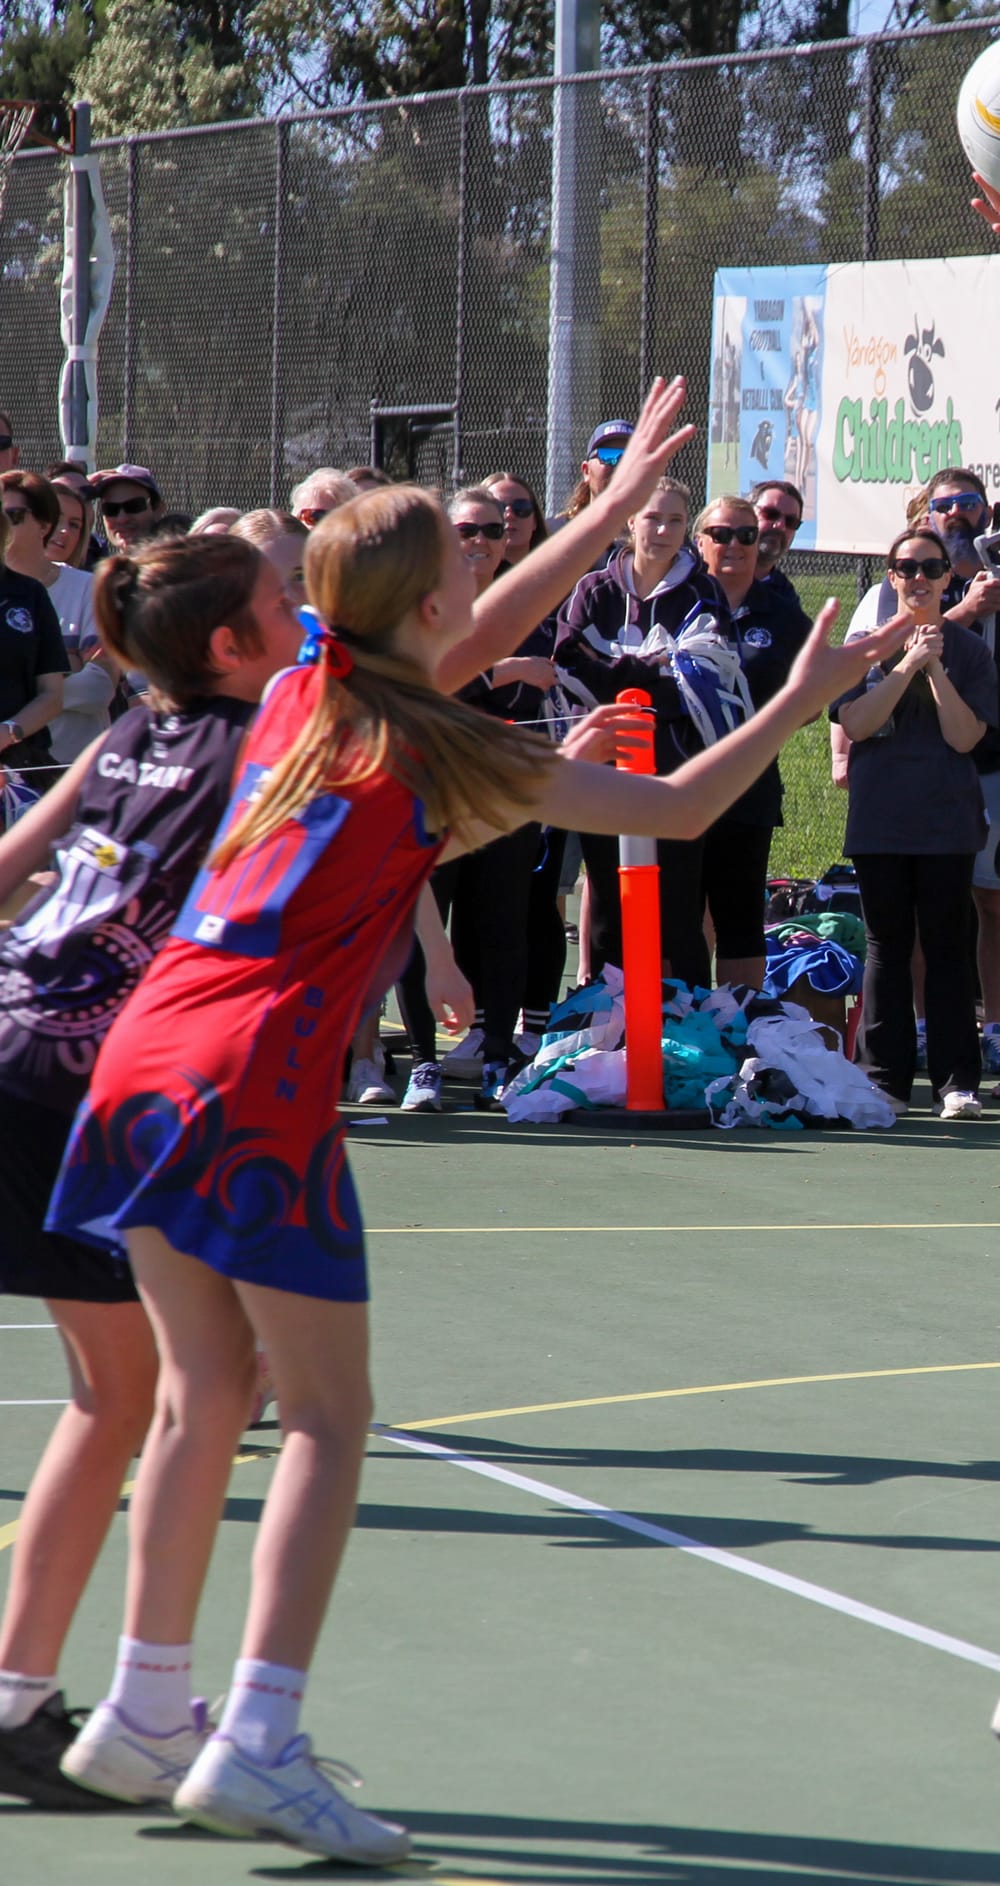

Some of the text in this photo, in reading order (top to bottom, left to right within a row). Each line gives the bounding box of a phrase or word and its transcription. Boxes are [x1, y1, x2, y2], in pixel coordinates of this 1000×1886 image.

[754, 300, 785, 322] YARRAGON
[750, 329, 782, 352] FOOTBALL
[843, 325, 897, 396] Yarragon
[832, 396, 963, 484] Children's
[98, 753, 194, 791] CATANI
